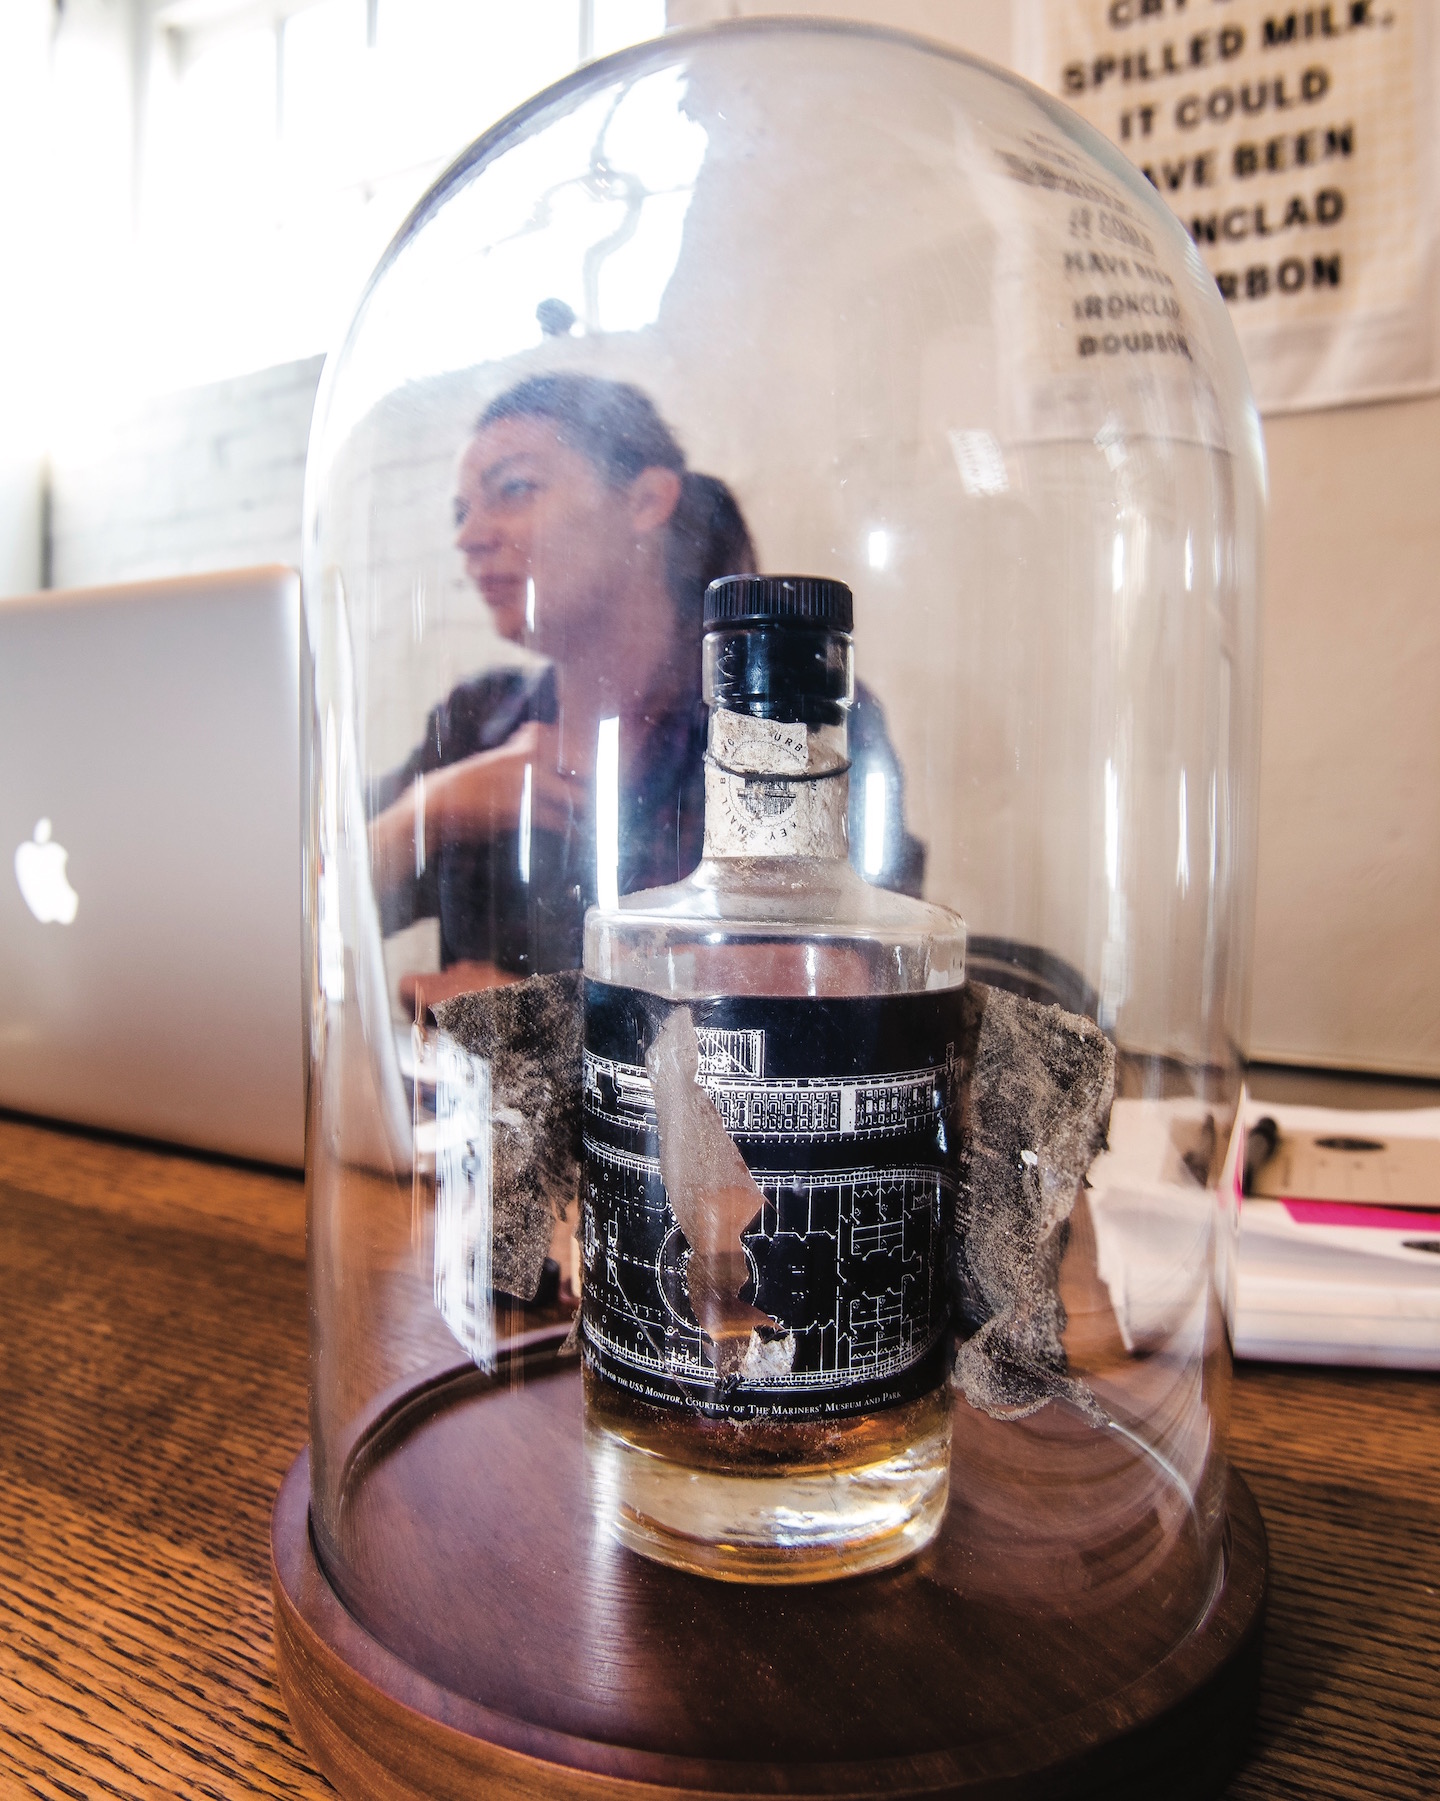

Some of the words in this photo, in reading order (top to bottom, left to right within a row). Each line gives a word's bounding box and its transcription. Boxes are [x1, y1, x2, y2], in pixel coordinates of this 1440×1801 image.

[1063, 24, 1244, 97] SPILLED
[1262, 0, 1395, 50] MILK.
[1120, 102, 1156, 141] IT
[1175, 64, 1331, 131] COULD
[1141, 150, 1215, 192] AVE
[1234, 123, 1354, 179] BEEN
[1190, 186, 1345, 244] NCLAD
[1073, 294, 1181, 320] IRONCLAD
[1215, 253, 1342, 303] RBON
[617, 1376, 628, 1387] THE
[629, 1380, 644, 1394] USS
[685, 1396, 731, 1413] COURTESY
[825, 1400, 862, 1412] MUSEUM
